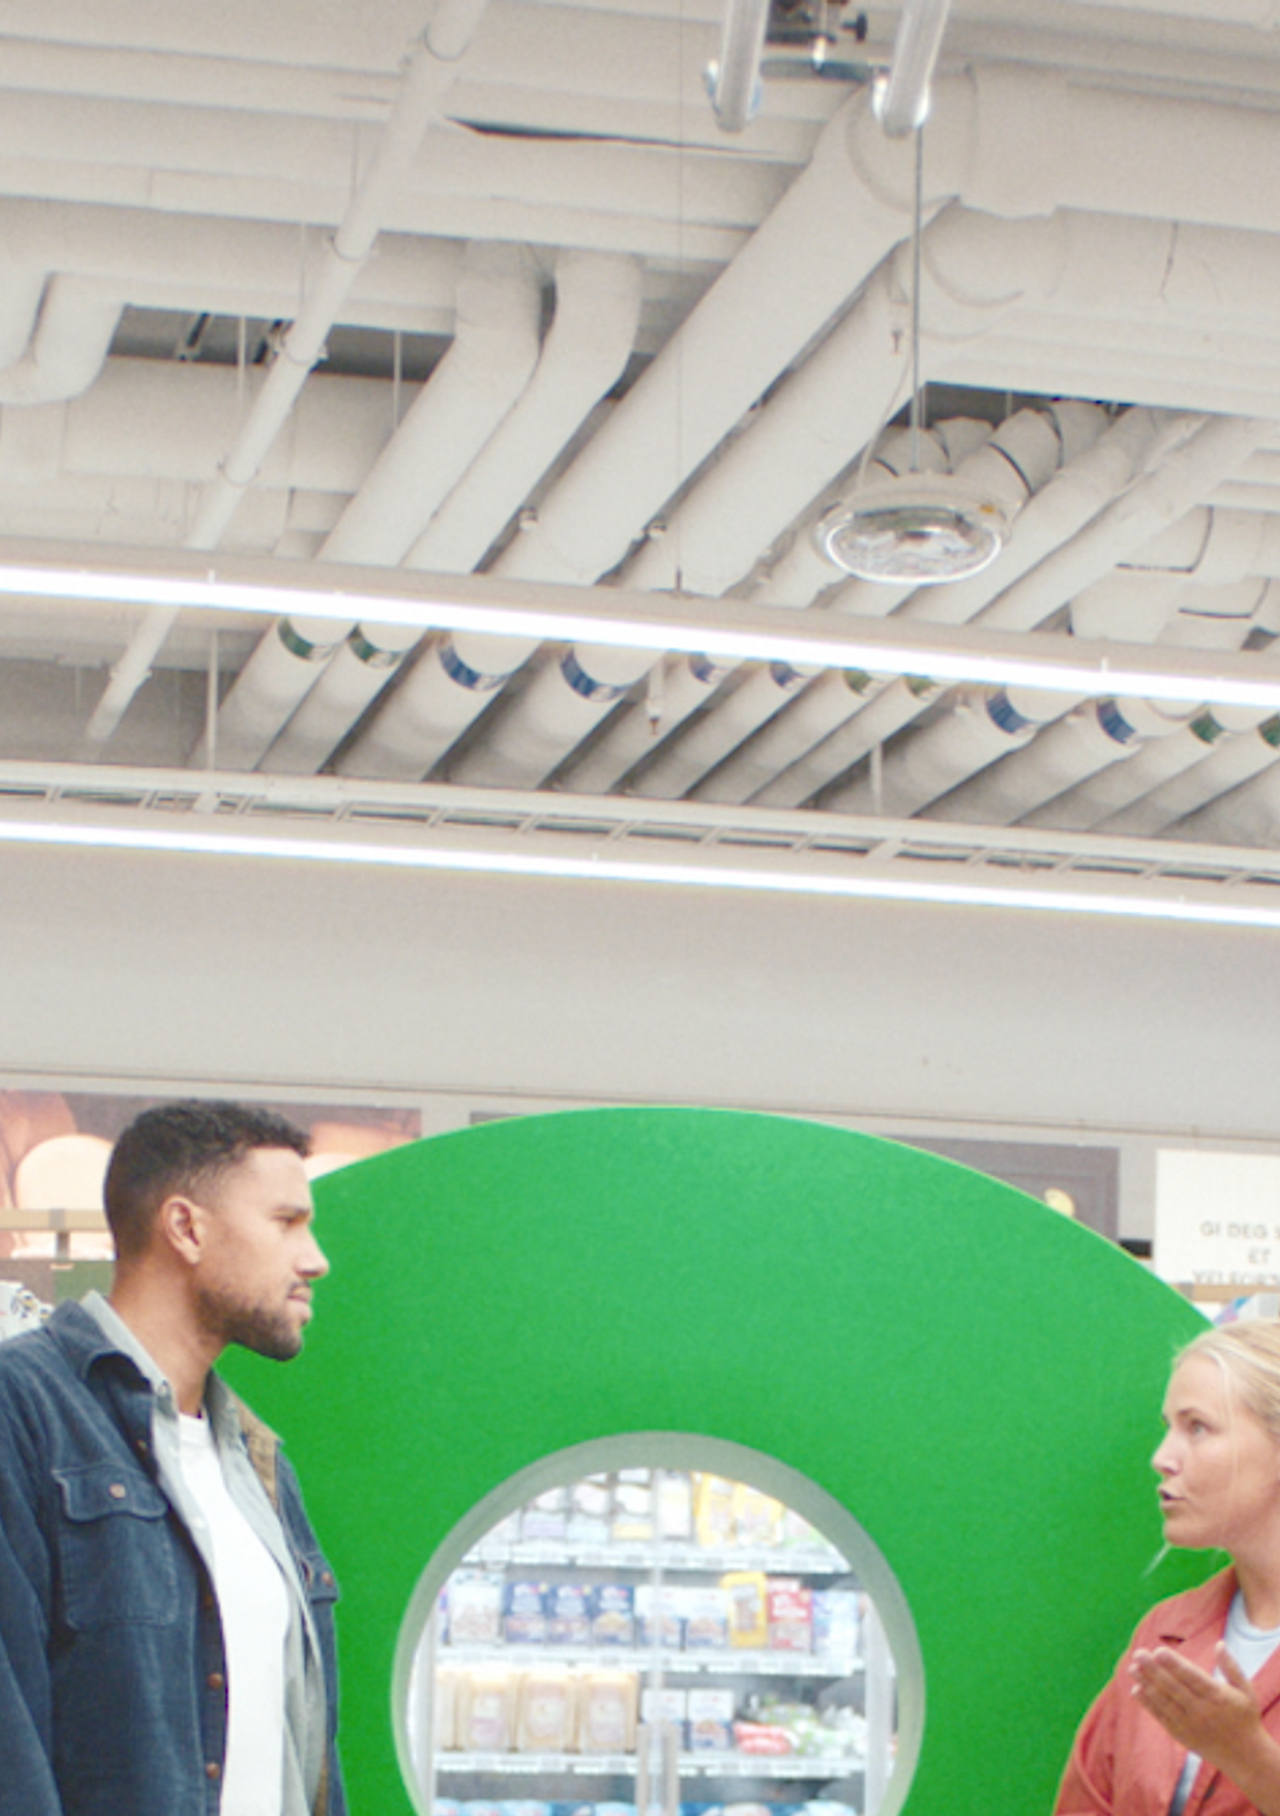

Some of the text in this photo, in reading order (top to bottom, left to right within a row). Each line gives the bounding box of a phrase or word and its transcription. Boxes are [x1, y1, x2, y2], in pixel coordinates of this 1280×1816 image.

[1201, 1221, 1220, 1236] GI
[1228, 1223, 1268, 1239] DEG
[1249, 1248, 1270, 1264] ET
